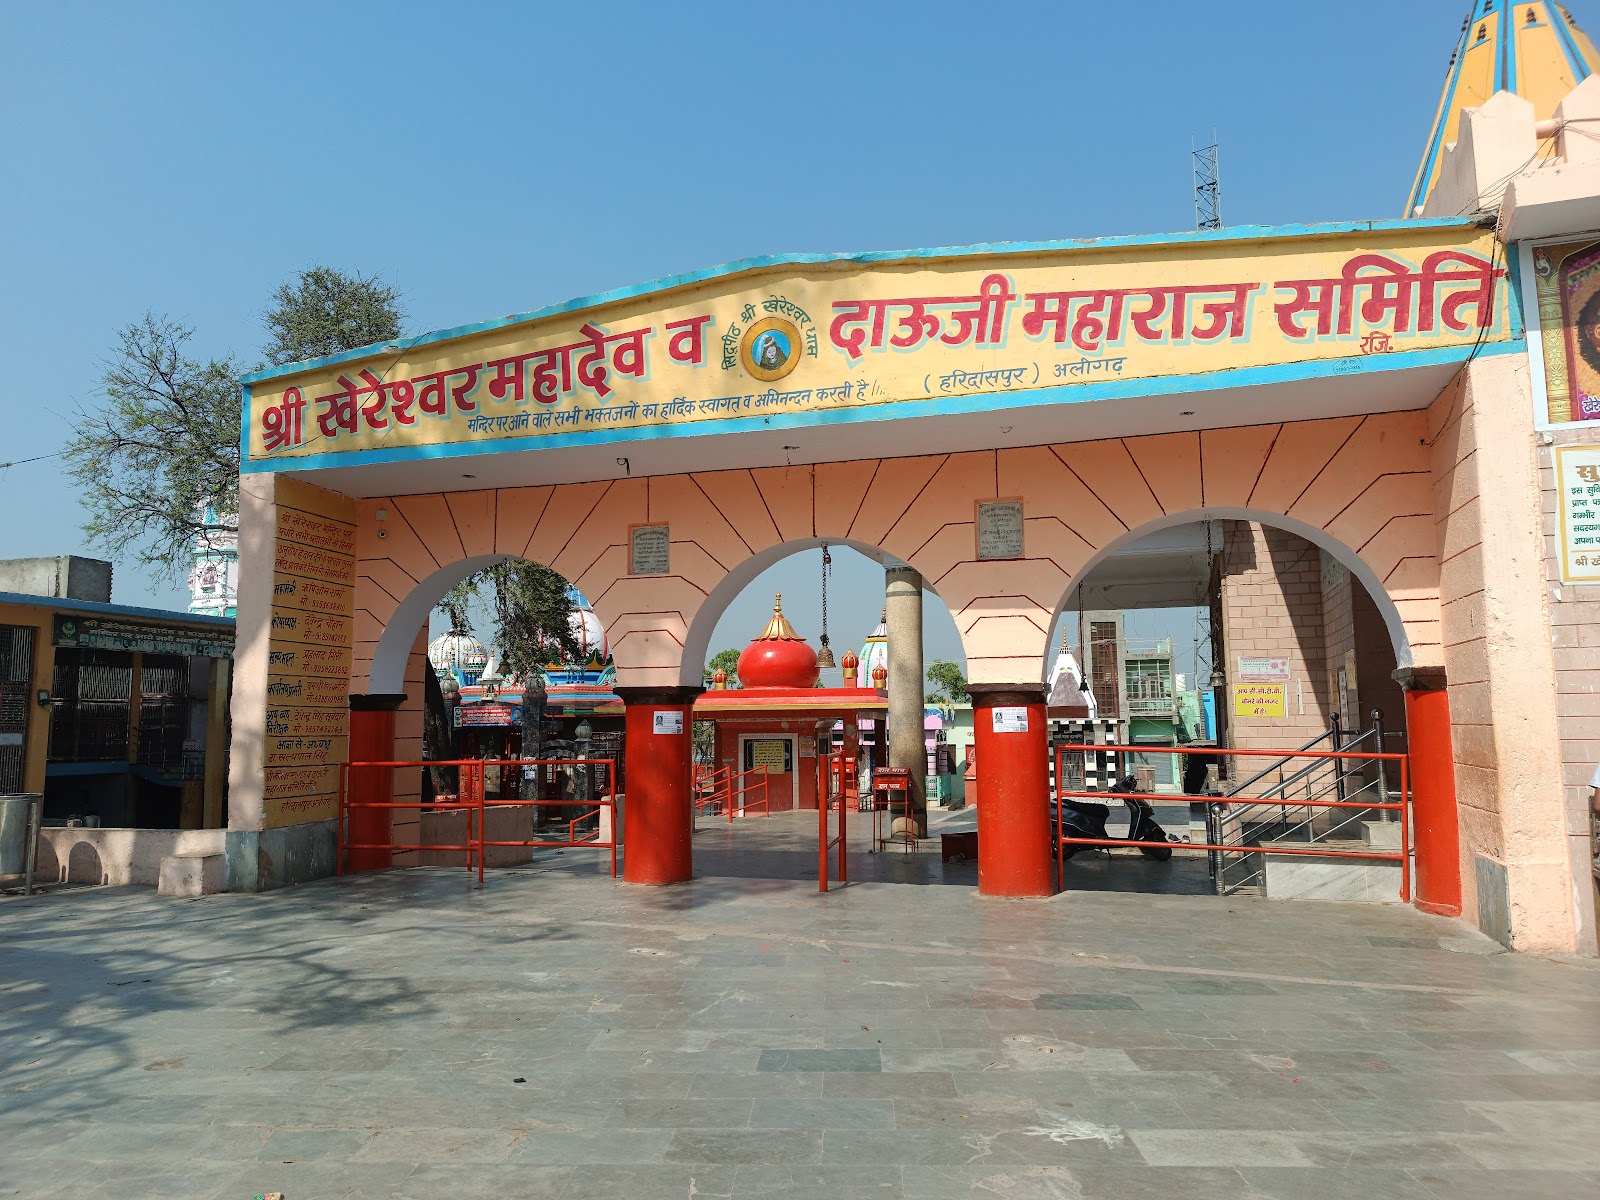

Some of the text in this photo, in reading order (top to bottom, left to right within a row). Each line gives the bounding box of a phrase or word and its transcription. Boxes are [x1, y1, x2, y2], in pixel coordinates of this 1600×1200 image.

[741, 303, 757, 323] श्री
[262, 386, 307, 451] श्री
[487, 324, 652, 404] महादेव
[665, 315, 711, 364] व
[829, 273, 1017, 359] दाऊजी
[1022, 283, 1260, 352] महाराज
[1274, 250, 1504, 338] समिति
[532, 408, 552, 429] वाले
[555, 406, 580, 426] सभी
[643, 402, 659, 418] का
[660, 397, 696, 420] हार्दिक
[698, 395, 742, 413] स्वागत
[743, 395, 755, 408] व
[816, 381, 854, 403] करती
[1575, 465, 1600, 482] सु
